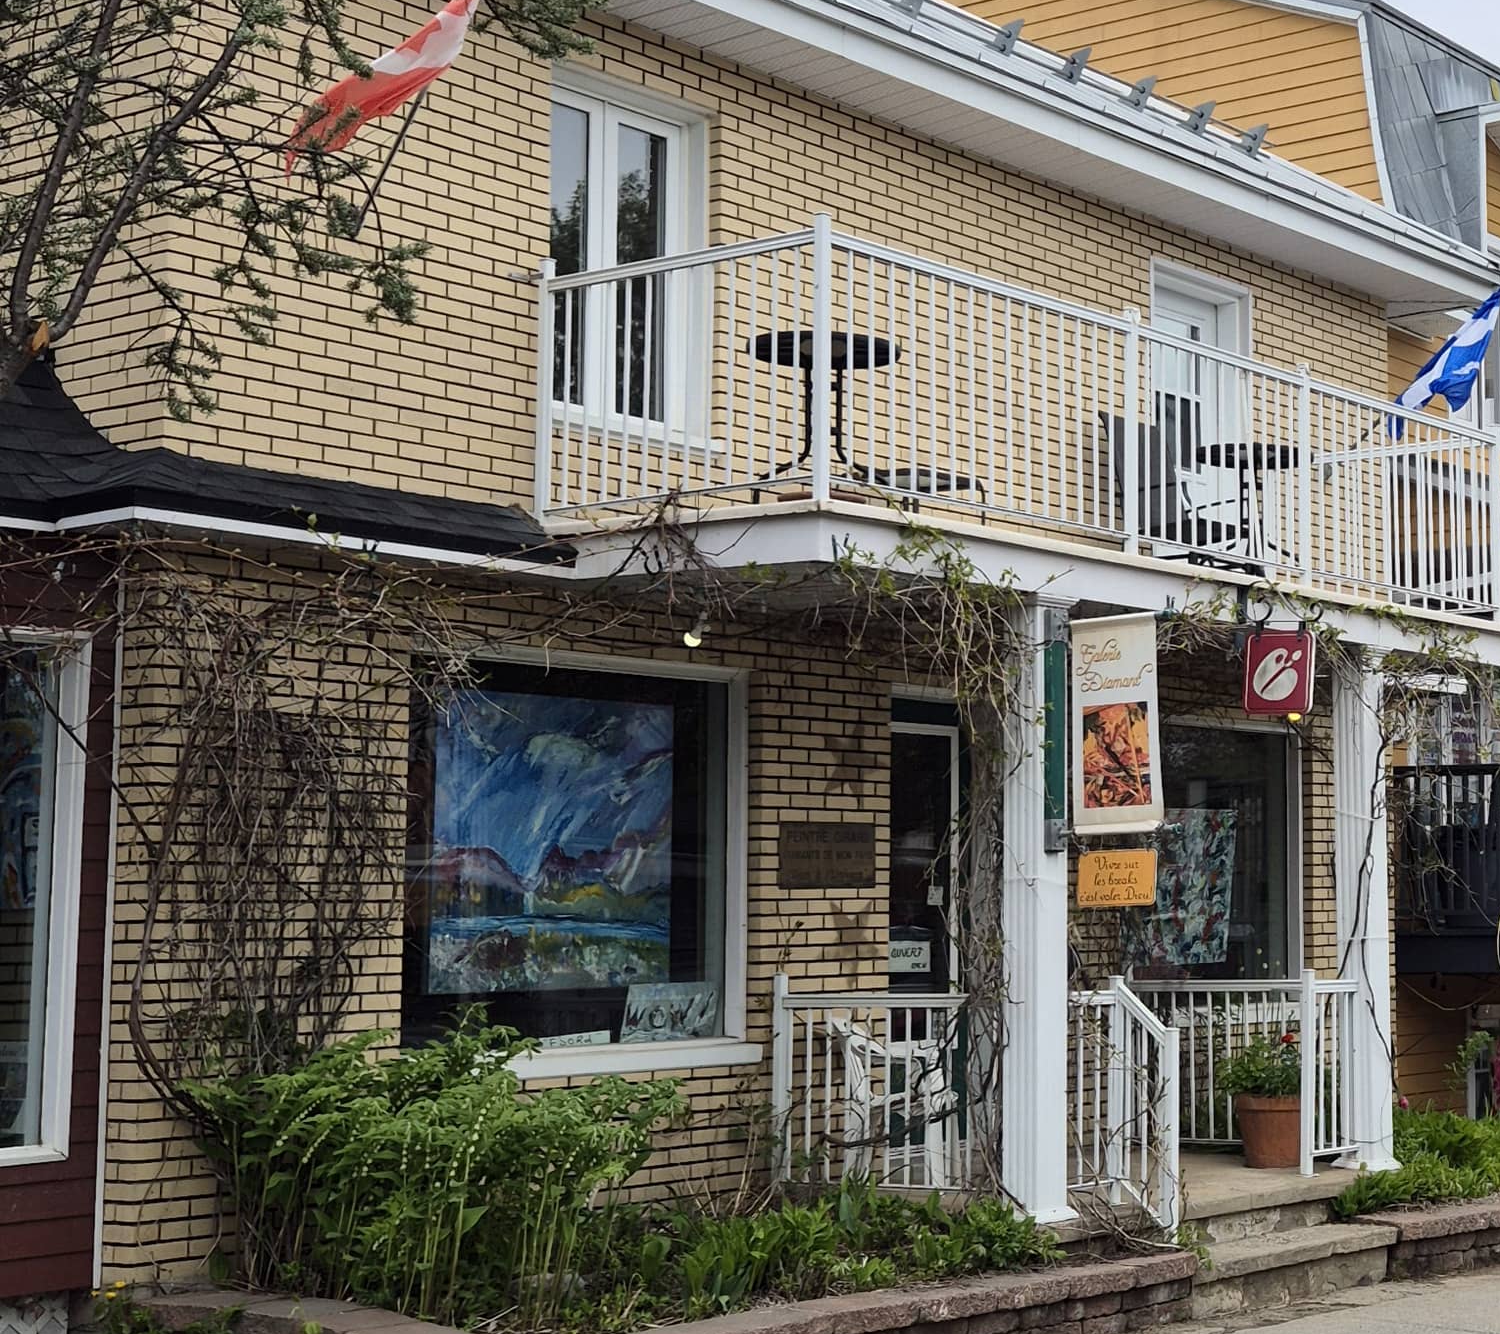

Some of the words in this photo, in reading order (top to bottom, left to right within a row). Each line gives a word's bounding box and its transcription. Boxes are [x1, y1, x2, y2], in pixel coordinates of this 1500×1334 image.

[1094, 856, 1121, 870] Vivre
[1124, 861, 1140, 869] sur
[1094, 872, 1106, 886] les
[890, 946, 924, 959] OUVERT
